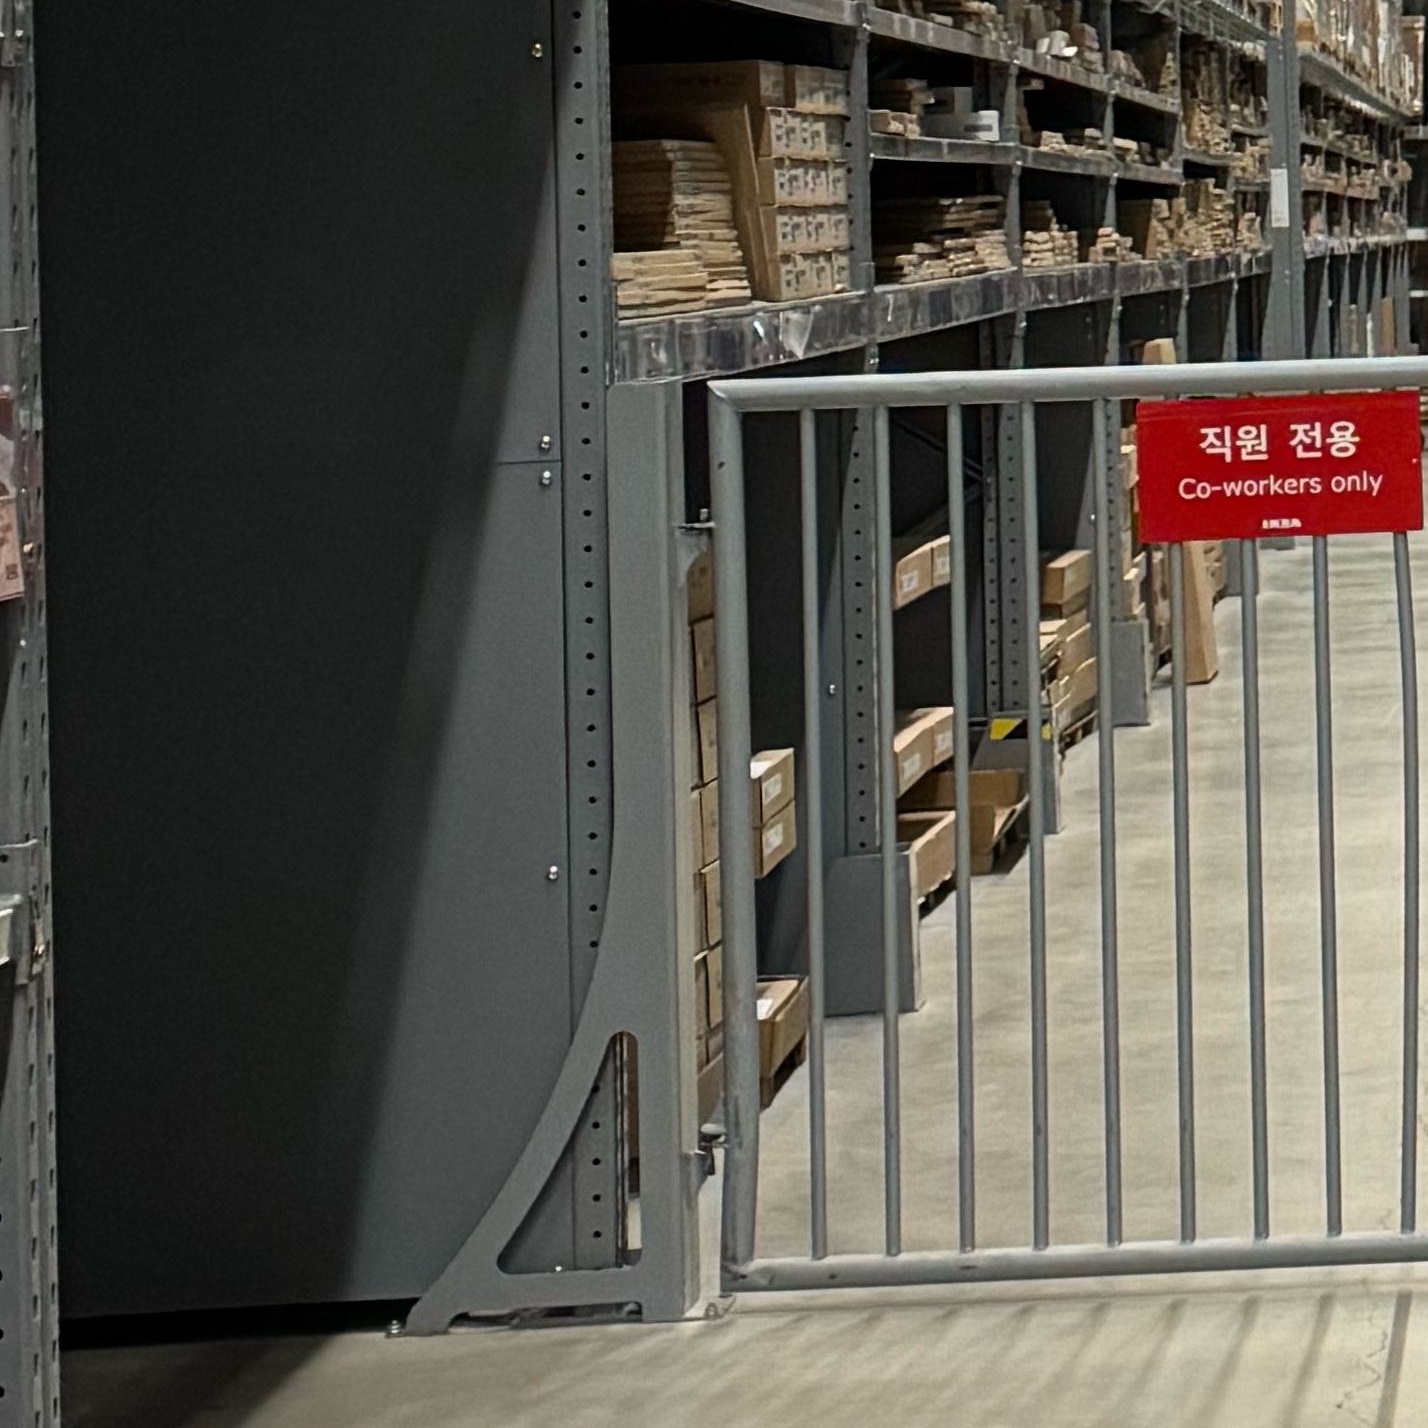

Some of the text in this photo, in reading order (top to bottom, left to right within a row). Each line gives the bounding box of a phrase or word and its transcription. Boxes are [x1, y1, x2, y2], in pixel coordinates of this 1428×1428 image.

[1198, 420, 1361, 464] 직원 전용
[1178, 470, 1384, 500] Co-workers only
